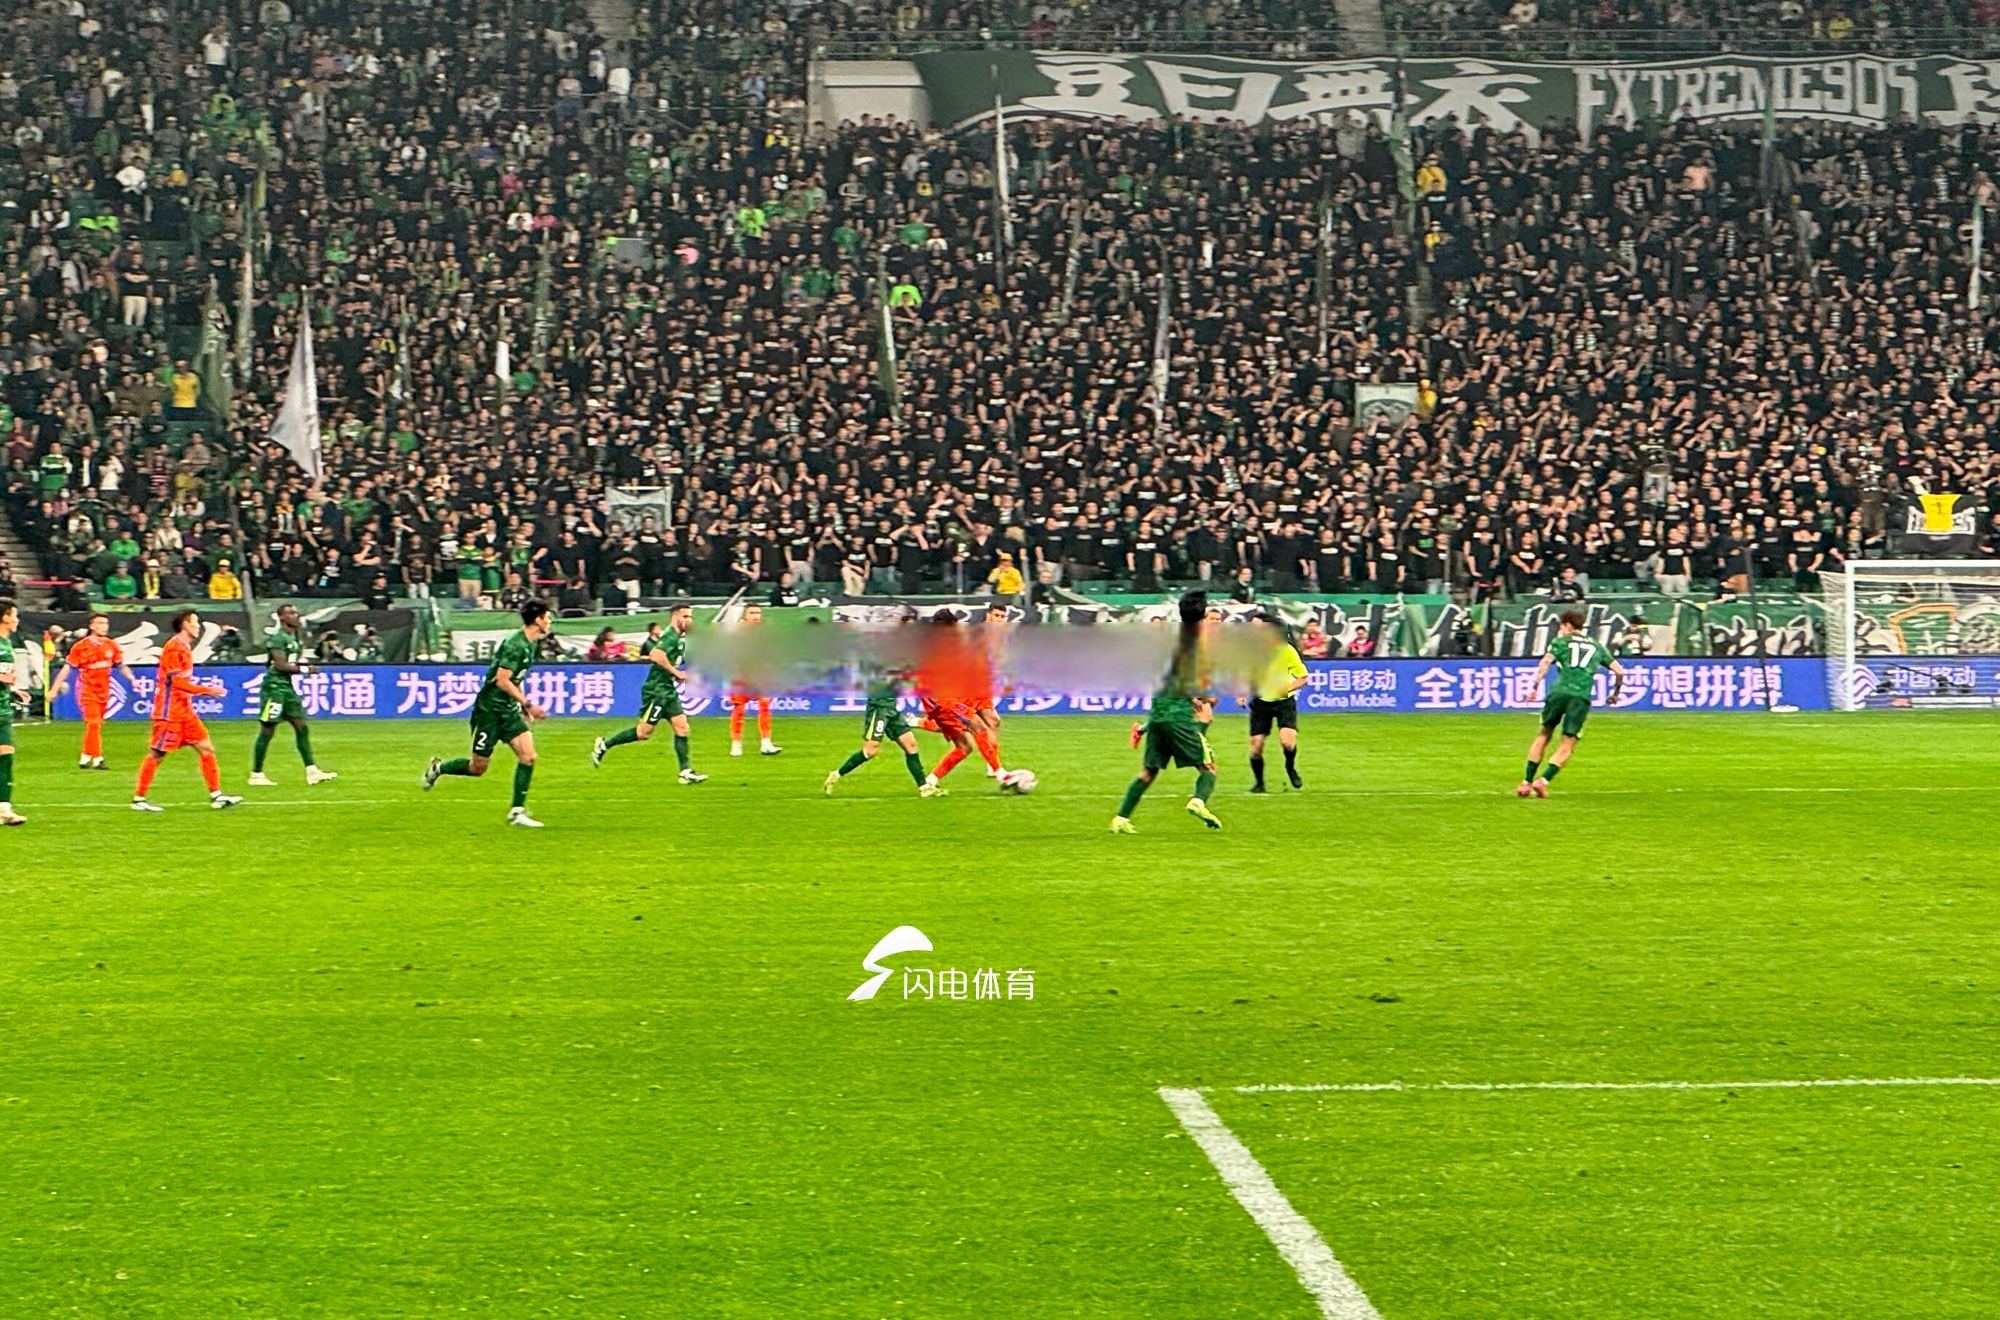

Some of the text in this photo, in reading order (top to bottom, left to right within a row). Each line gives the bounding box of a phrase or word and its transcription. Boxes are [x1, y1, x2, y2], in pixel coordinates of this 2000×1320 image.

[1568, 642, 1597, 668] 17
[1307, 669, 1397, 691] 中国移动
[1415, 667, 1546, 709] 全球通
[397, 671, 614, 715] 为梦拼搏
[1307, 693, 1397, 708] China Mobile
[654, 705, 662, 718] 7
[876, 720, 885, 734] 8
[477, 731, 488, 748] 2
